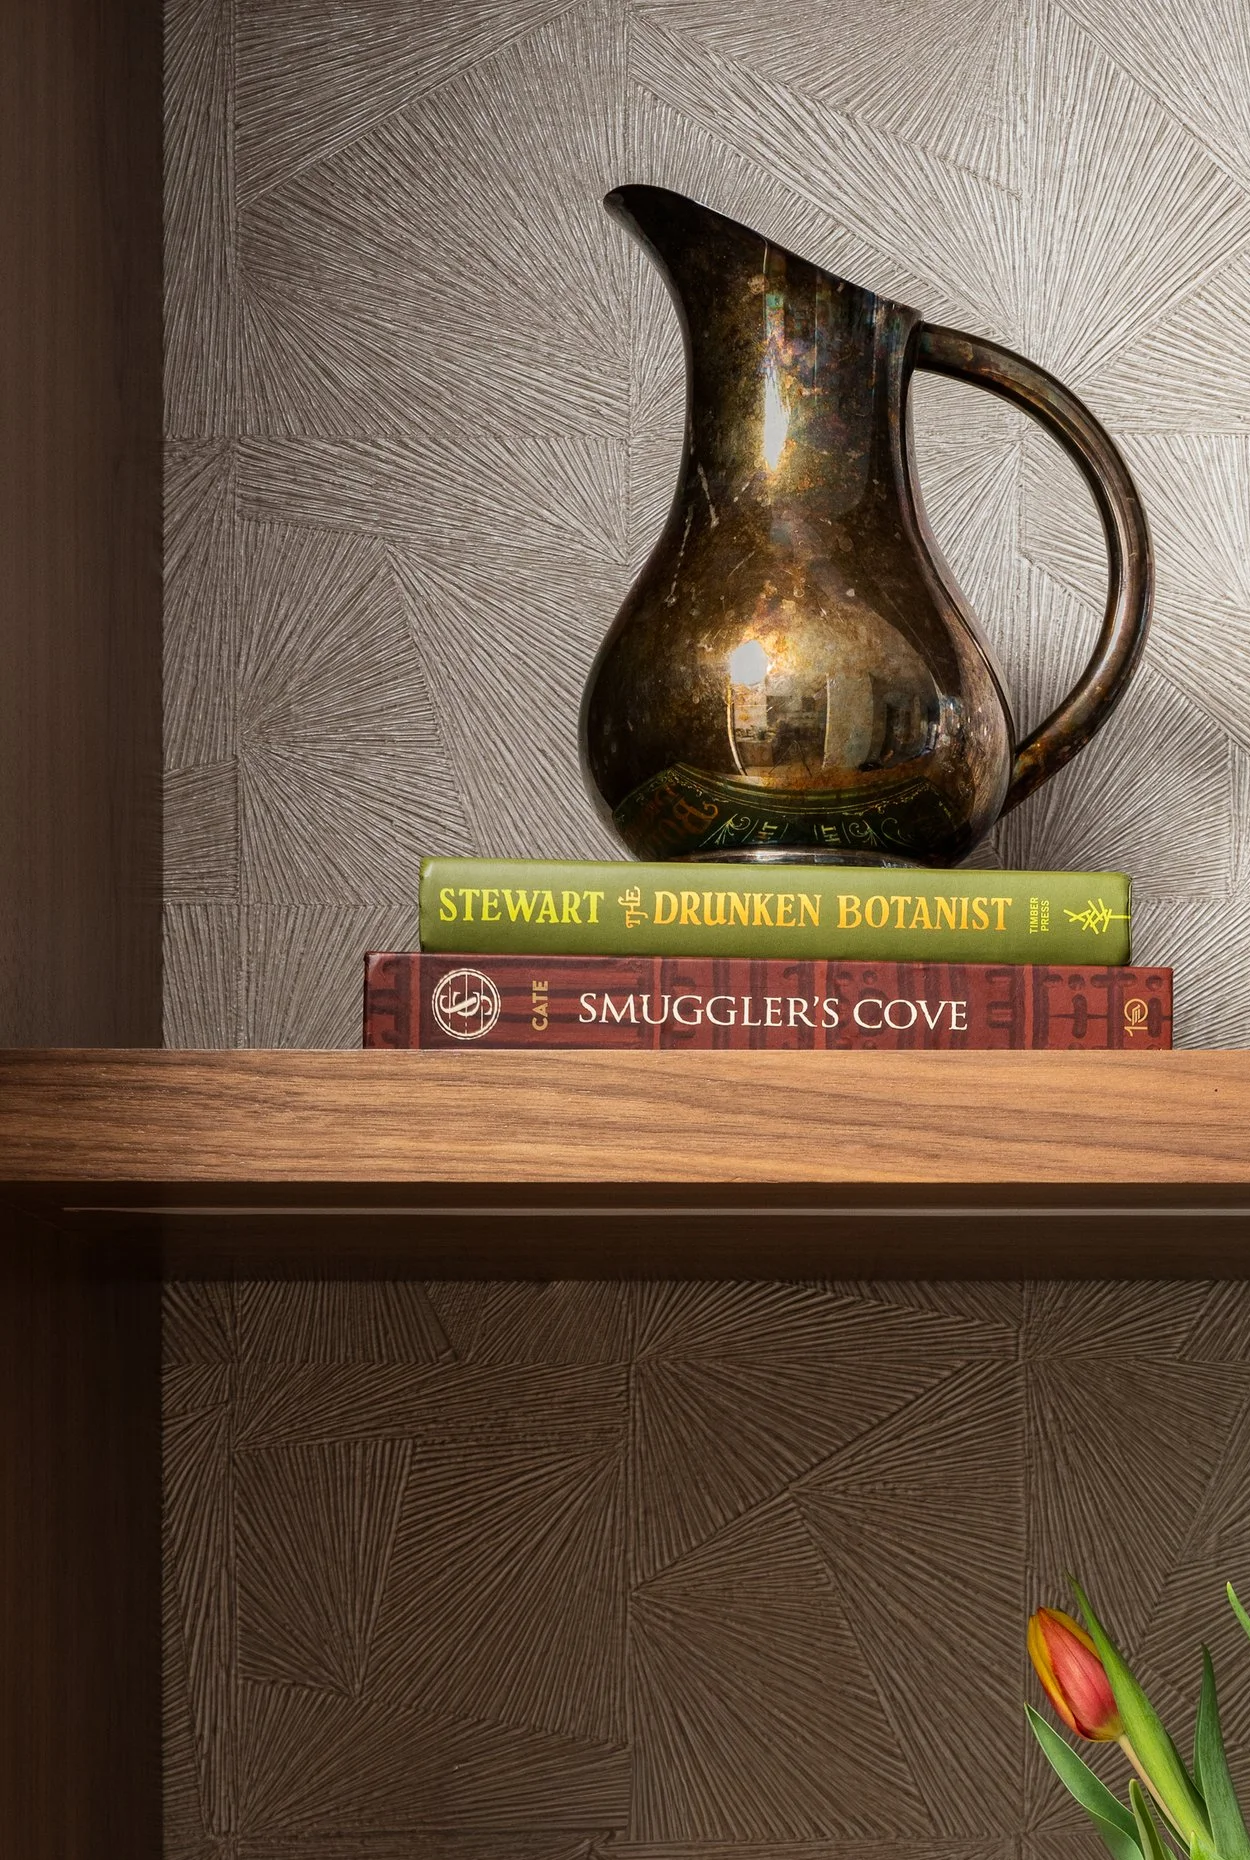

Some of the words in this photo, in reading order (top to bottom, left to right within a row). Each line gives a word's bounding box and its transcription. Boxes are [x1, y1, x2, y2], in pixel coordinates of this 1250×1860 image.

[439, 887, 604, 924] STEWART
[617, 885, 649, 929] THE
[653, 890, 822, 927] DRUNKEN
[837, 895, 1012, 931] BOTANIST
[1029, 897, 1039, 934] TIMBER
[1040, 900, 1050, 932] PRESS
[532, 980, 549, 1031] CATE
[578, 992, 840, 1029] SMUGGLER'S
[853, 998, 968, 1031] COVE
